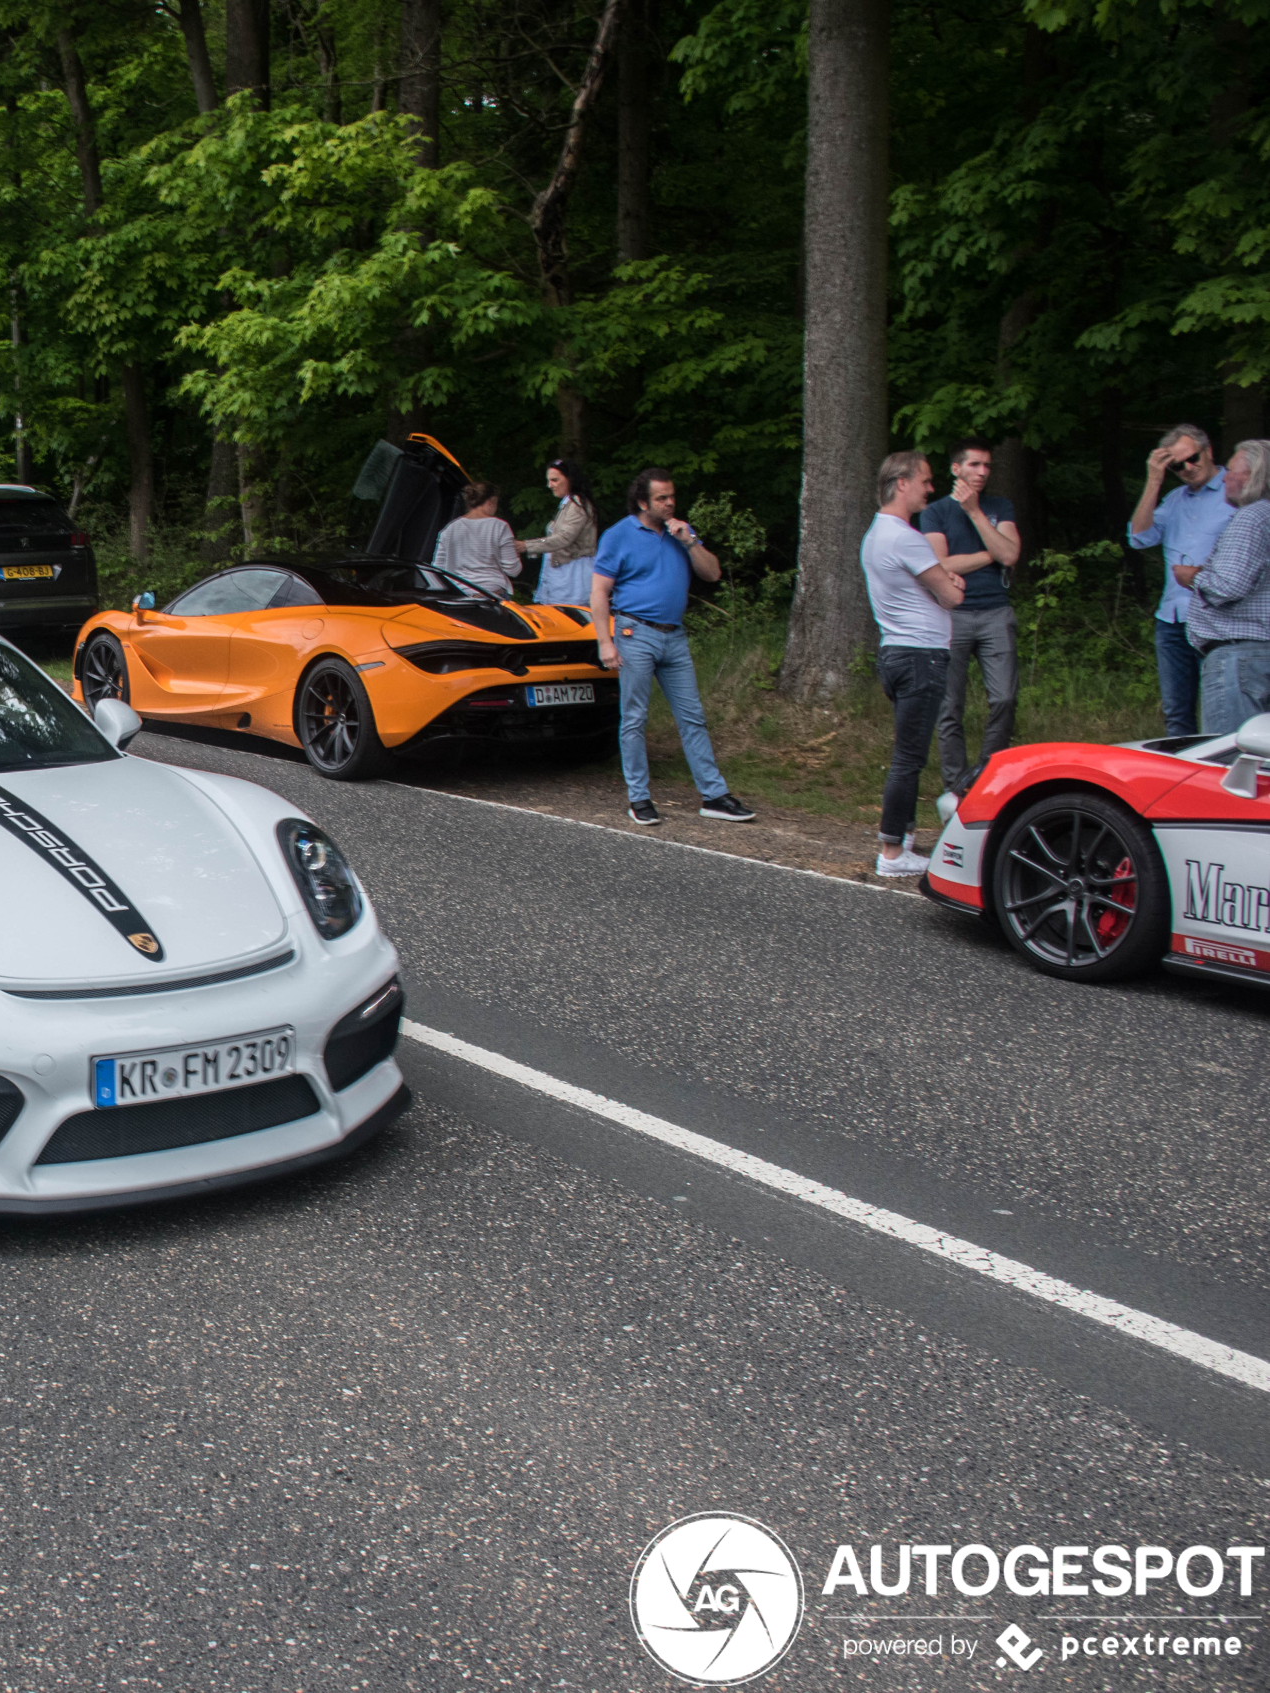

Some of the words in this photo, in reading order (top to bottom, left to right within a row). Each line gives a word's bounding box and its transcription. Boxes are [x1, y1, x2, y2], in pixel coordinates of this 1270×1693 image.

[7, 566, 49, 577] G-408-BJ
[535, 688, 545, 703] D
[553, 687, 570, 702] AM
[570, 685, 593, 701] 720
[1183, 859, 1270, 933] Mar
[1184, 937, 1257, 966] PIRELLI
[119, 1060, 159, 1098] KR
[183, 1050, 220, 1088] FM
[226, 1036, 292, 1080] 2309
